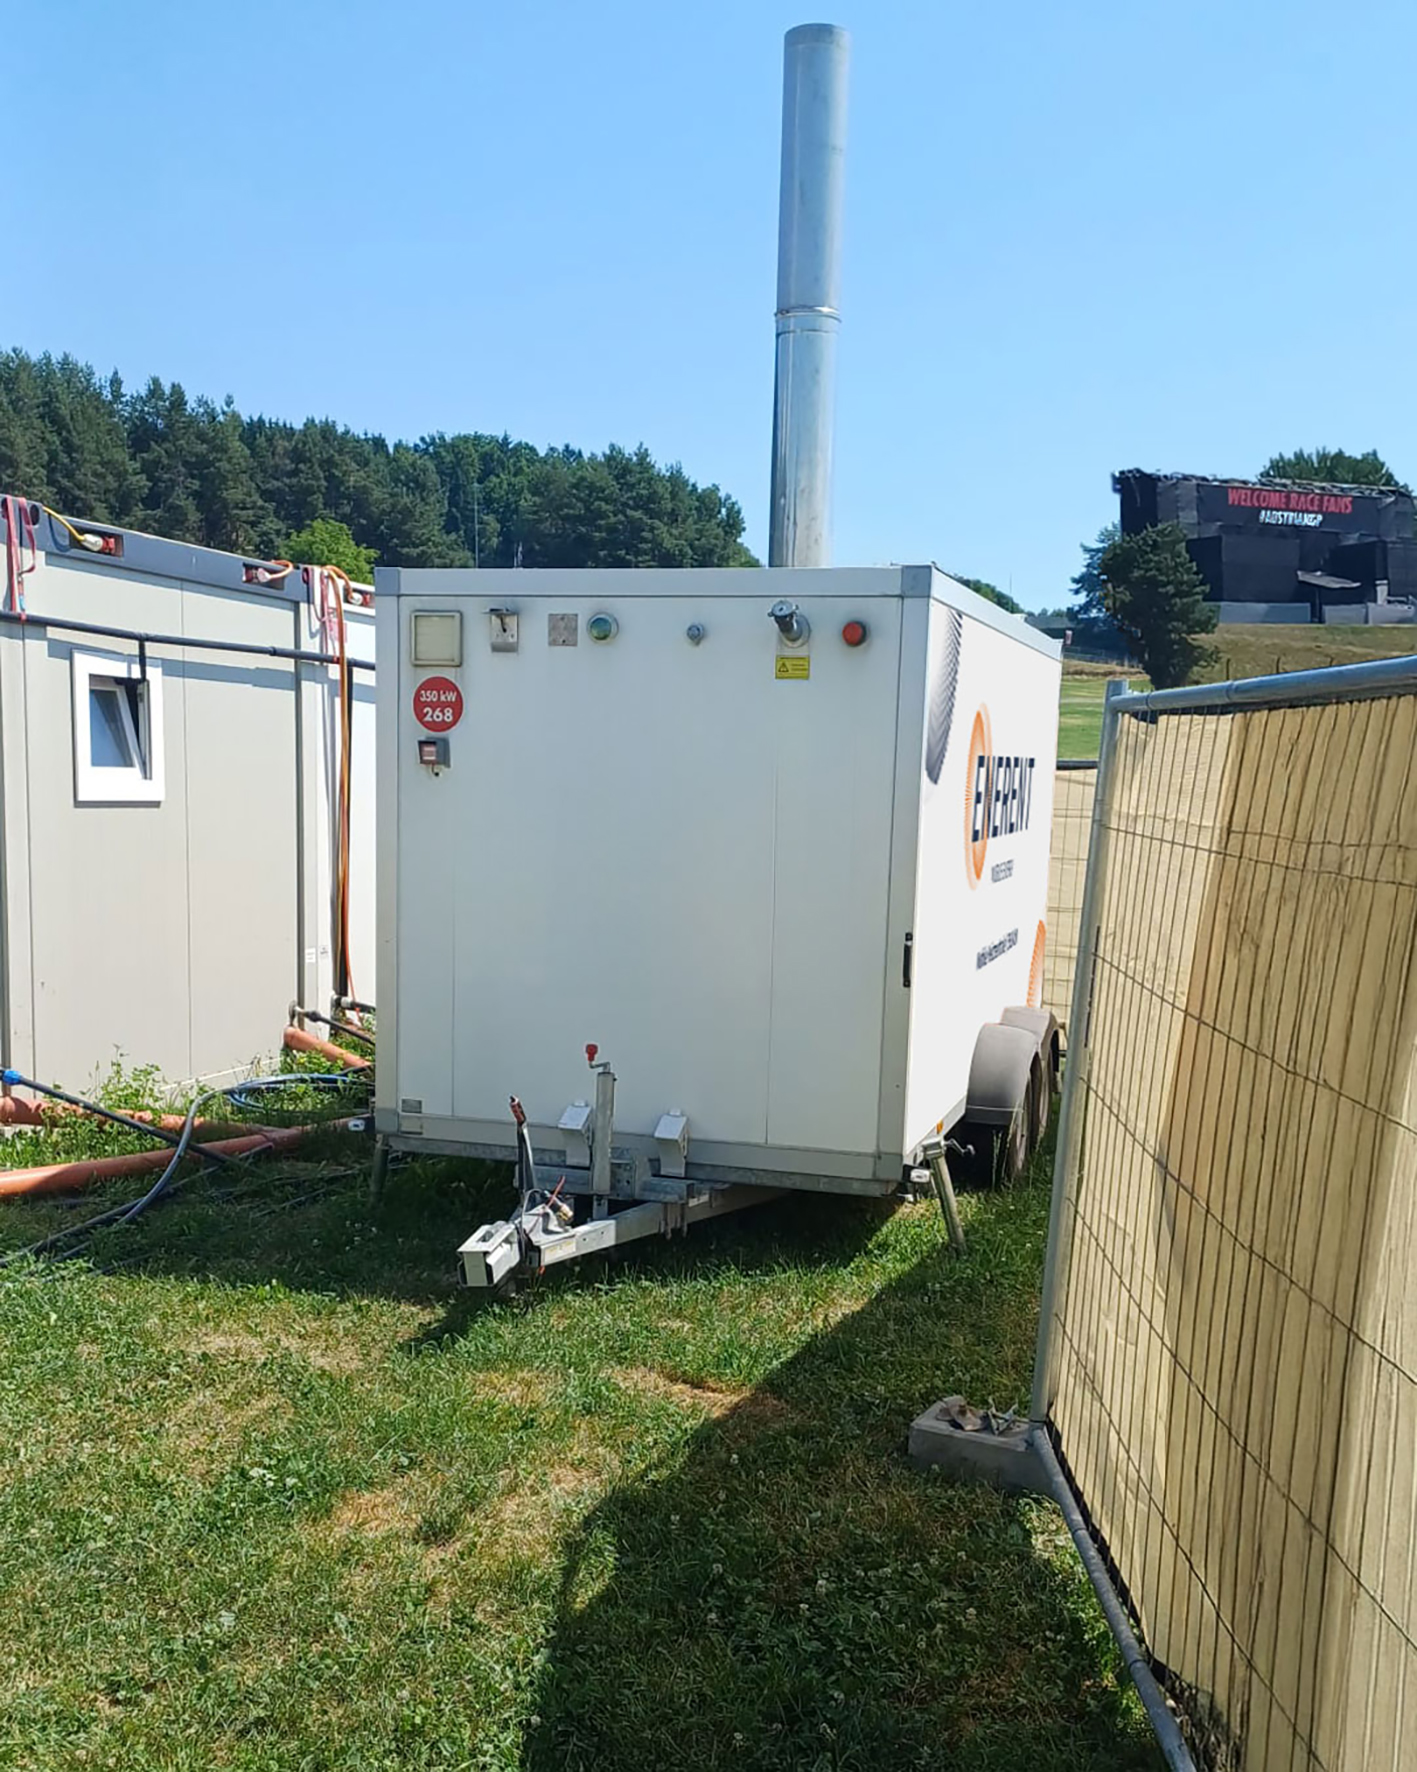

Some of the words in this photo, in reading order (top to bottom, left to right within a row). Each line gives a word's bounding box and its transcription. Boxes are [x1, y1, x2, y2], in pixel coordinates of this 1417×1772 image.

[1228, 487, 1286, 509] WELCOME
[1289, 492, 1320, 512] RACE
[1322, 495, 1353, 514] FANS
[420, 690, 438, 702] 350
[440, 690, 457, 702] kW
[423, 707, 453, 722] 268
[971, 755, 1035, 843] ENERENT
